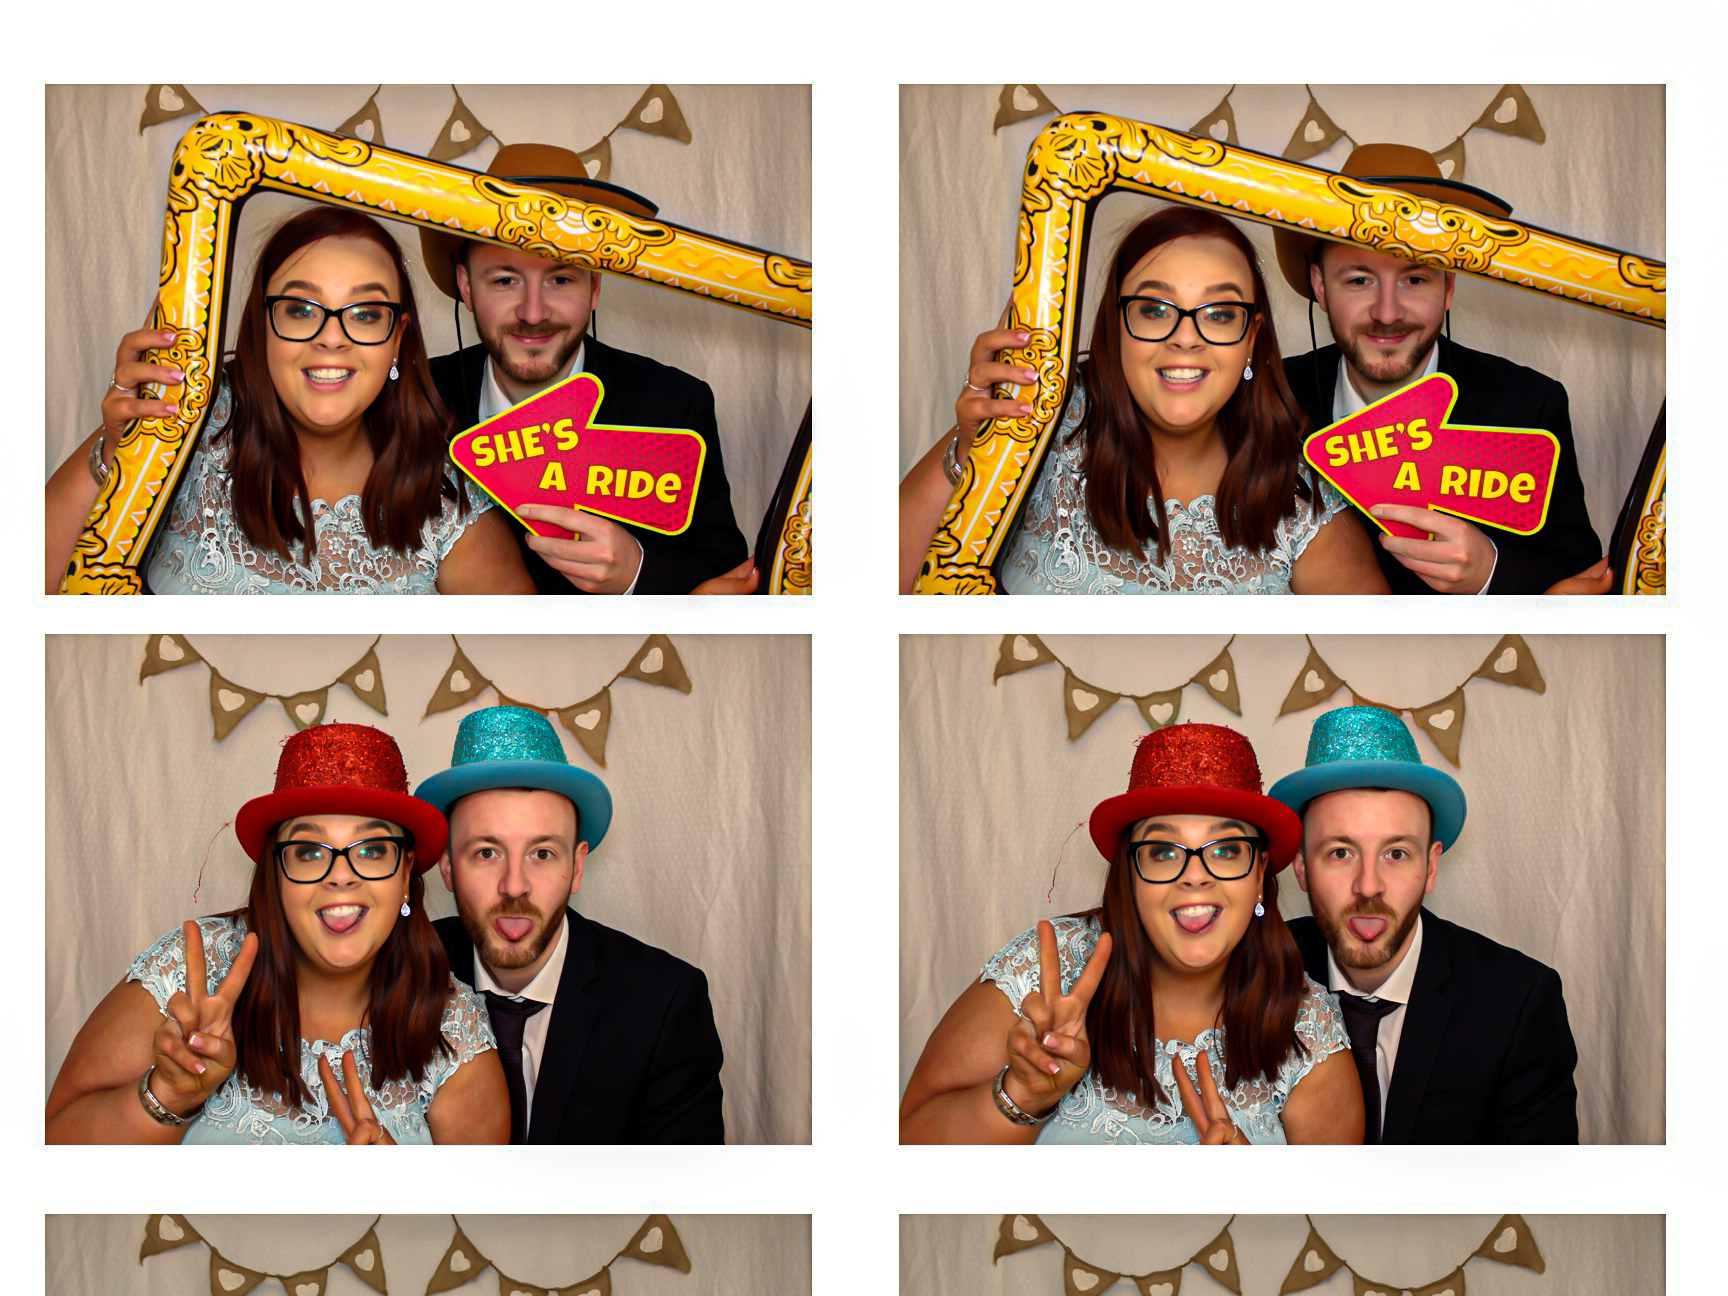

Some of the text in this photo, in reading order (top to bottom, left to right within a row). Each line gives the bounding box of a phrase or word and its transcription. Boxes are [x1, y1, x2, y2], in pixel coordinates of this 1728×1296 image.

[471, 418, 579, 467] SHE'S
[1325, 418, 1433, 467] SHE'S
[538, 461, 567, 491] A
[1392, 461, 1421, 491] A
